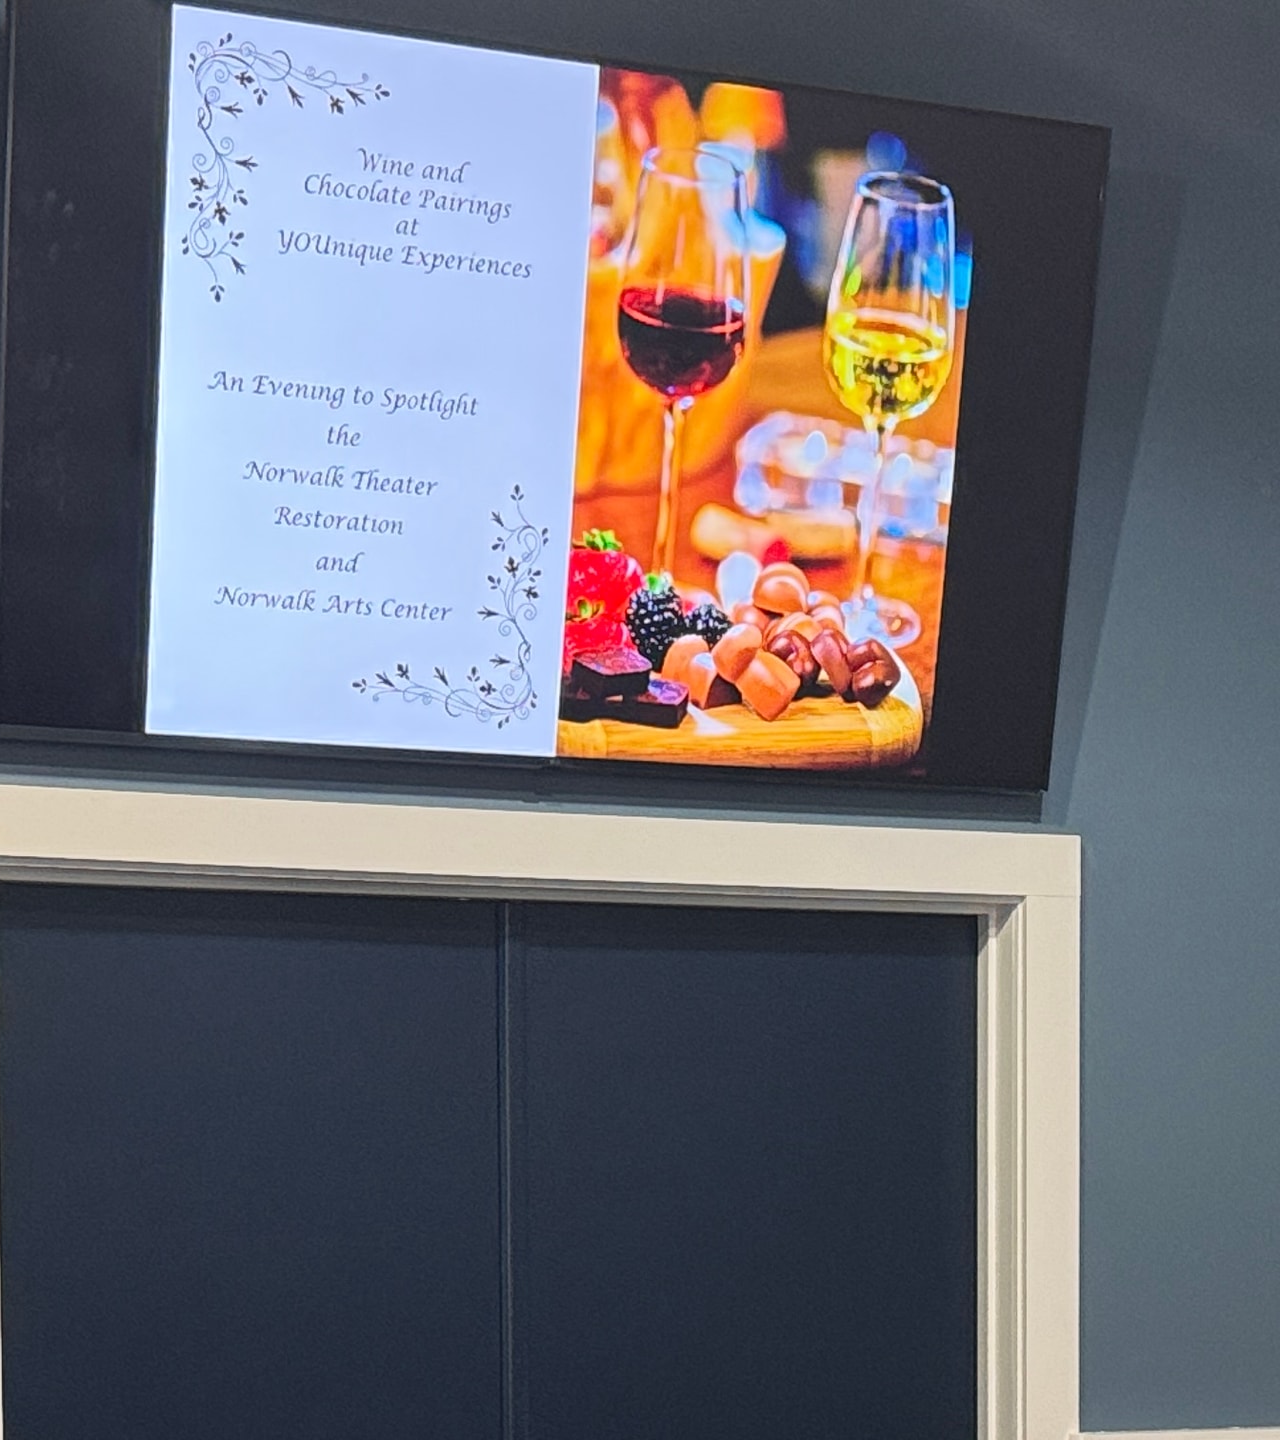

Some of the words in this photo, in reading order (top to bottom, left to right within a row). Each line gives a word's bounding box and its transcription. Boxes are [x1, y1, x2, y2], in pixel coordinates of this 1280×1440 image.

[358, 148, 414, 177] Wine
[422, 161, 471, 183] and
[304, 174, 411, 206] Chocolate
[418, 188, 512, 224] Pairings
[396, 218, 419, 236] at
[278, 230, 393, 266] YOUnique
[401, 245, 532, 278] Experiences
[207, 371, 244, 392] An
[252, 374, 345, 409] Evening
[353, 386, 374, 405] to
[380, 388, 479, 420] Spotlight
[326, 423, 361, 446] the
[242, 461, 344, 488] Norwalk
[351, 469, 438, 496] Theater
[274, 506, 404, 535] Restoration
[316, 552, 365, 573] and
[214, 586, 316, 612] Norwalk
[322, 594, 372, 616] Arts
[381, 599, 452, 621] Center
